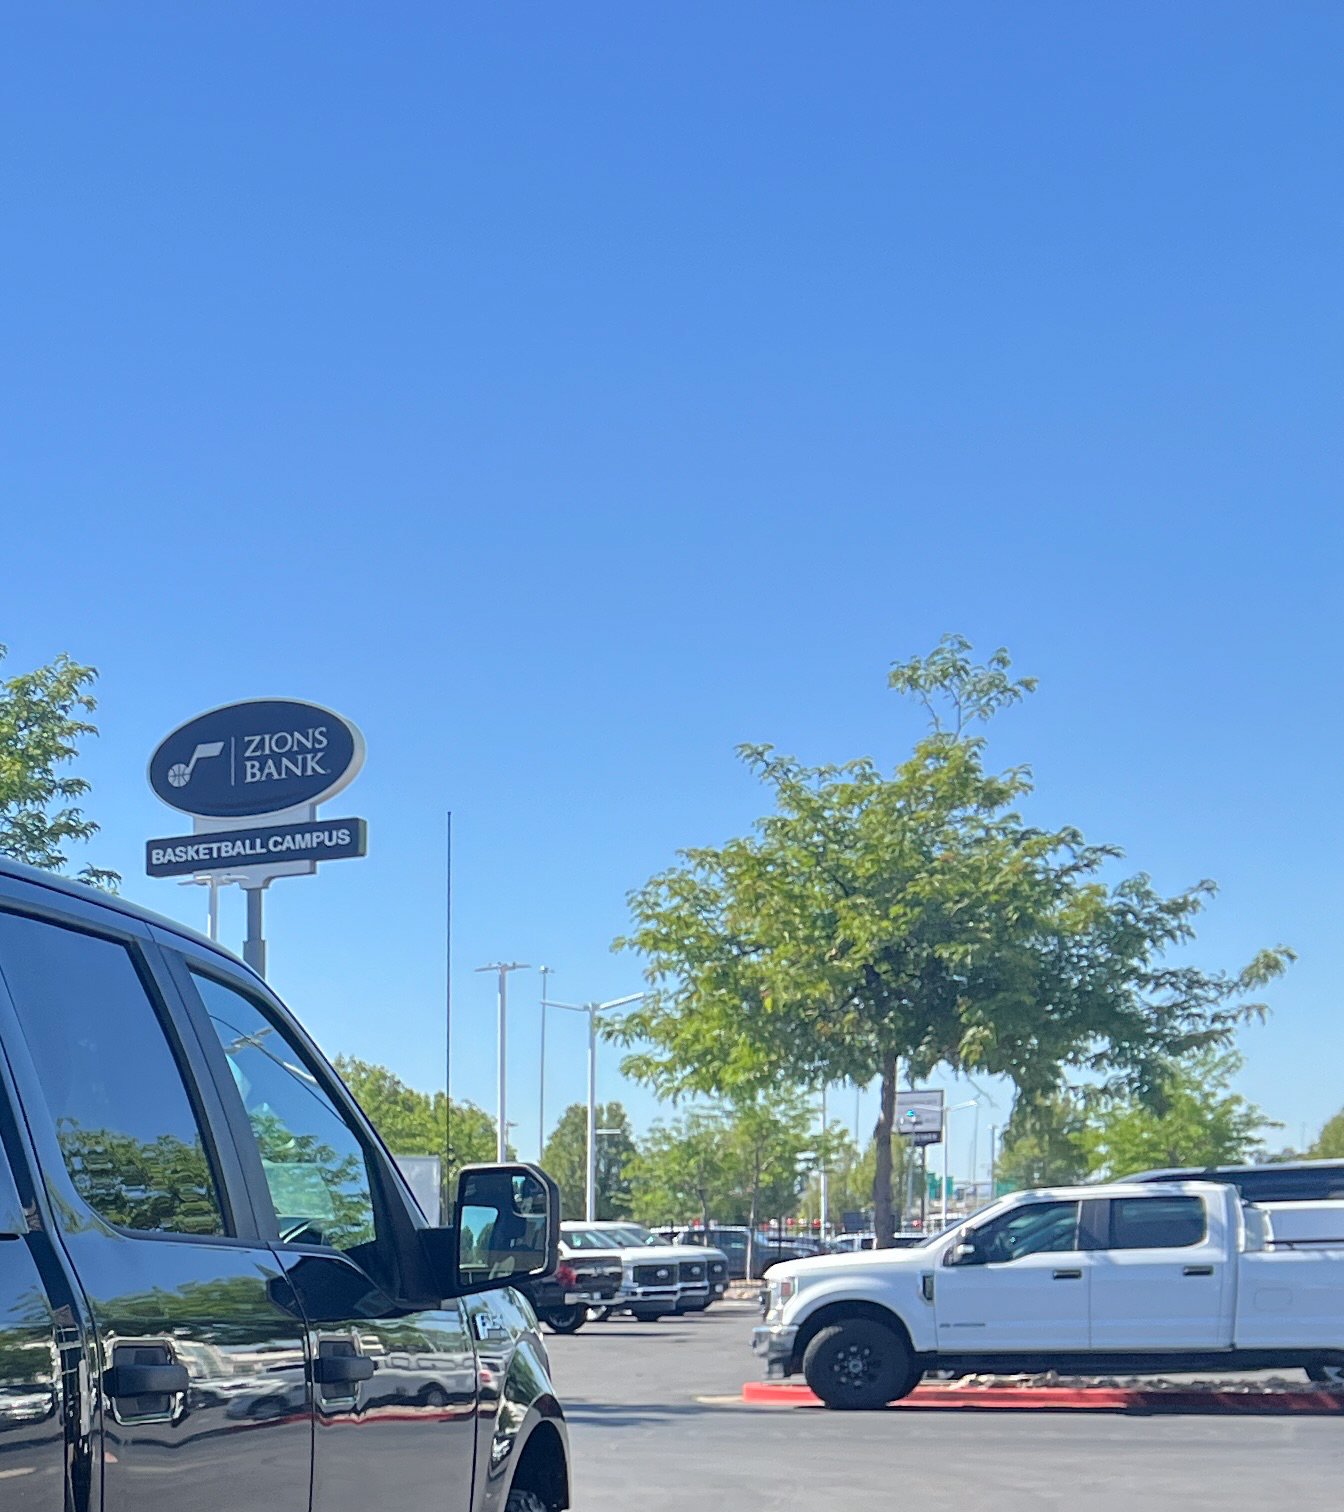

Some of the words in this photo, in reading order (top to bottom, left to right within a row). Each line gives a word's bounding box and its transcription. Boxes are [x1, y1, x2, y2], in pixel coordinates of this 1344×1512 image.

[244, 727, 328, 758] ZIONS
[244, 751, 328, 784] BANK
[151, 837, 268, 866] BASKETBALL
[268, 828, 352, 852] CAMPUS
